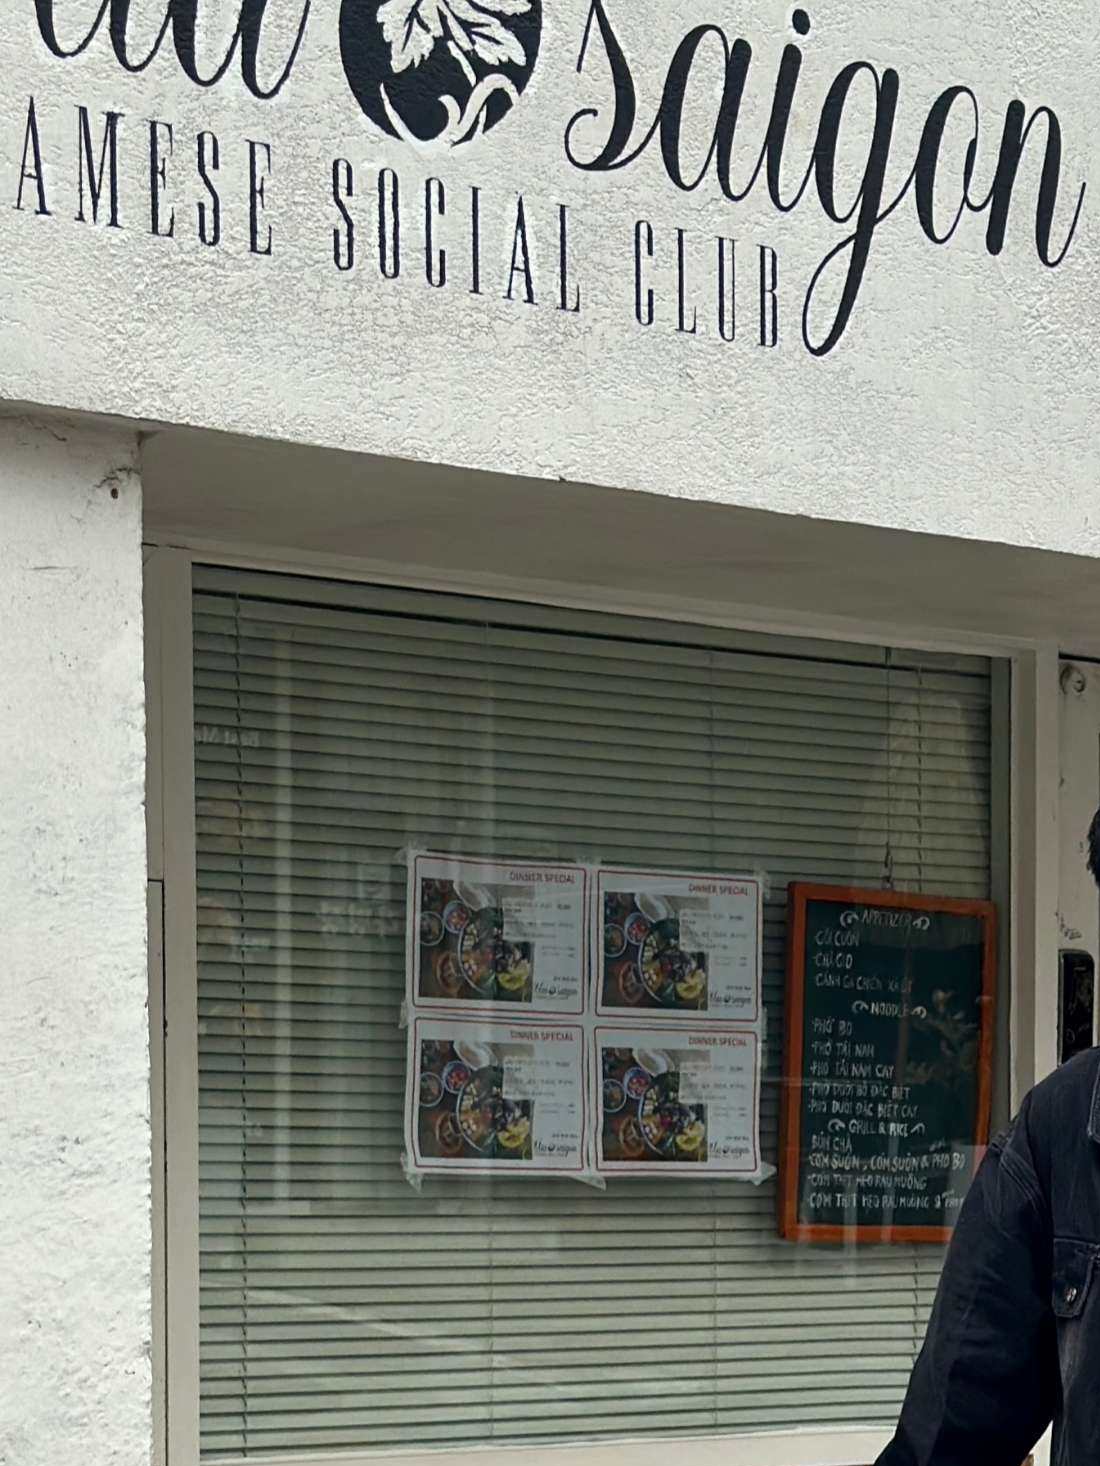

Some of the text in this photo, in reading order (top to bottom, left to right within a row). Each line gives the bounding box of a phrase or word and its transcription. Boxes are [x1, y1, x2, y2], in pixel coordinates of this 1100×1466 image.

[564, 0, 1087, 357] saigon
[12, 96, 778, 348] AMESE SOCIAL CLUB
[871, 1002, 910, 1017] NOODLE
[875, 1064, 894, 1078] CAY
[901, 1104, 918, 1118] CAY
[848, 1118, 877, 1135] GRILL
[889, 1122, 909, 1138] RICE
